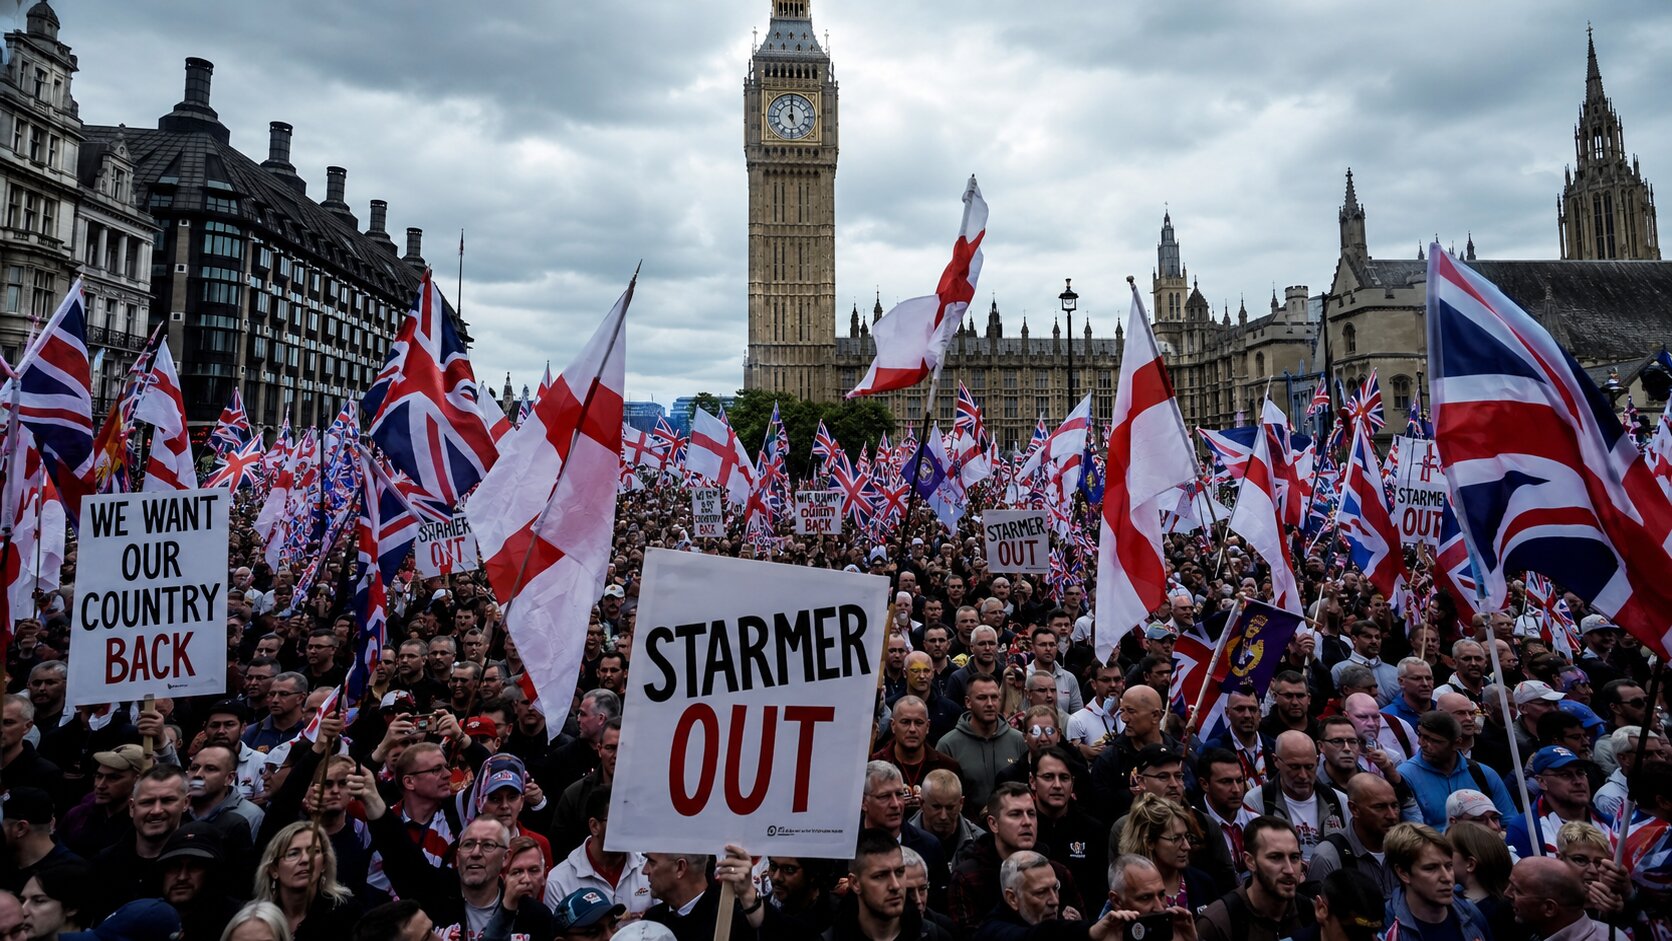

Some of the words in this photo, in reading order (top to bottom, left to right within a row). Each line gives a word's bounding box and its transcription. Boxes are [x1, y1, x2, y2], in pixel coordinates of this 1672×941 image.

[90, 501, 129, 538] WE
[142, 495, 218, 534] WANT
[1398, 487, 1446, 507] STARME
[805, 519, 831, 531] BACK
[987, 516, 1046, 542] STARMER
[1403, 507, 1443, 539] OUT
[122, 541, 182, 581] OUR
[998, 540, 1038, 566] OUT
[81, 583, 220, 631] COUNTRY
[105, 631, 196, 685] BACK
[643, 604, 871, 702] STARMER
[669, 703, 835, 816] OUT
